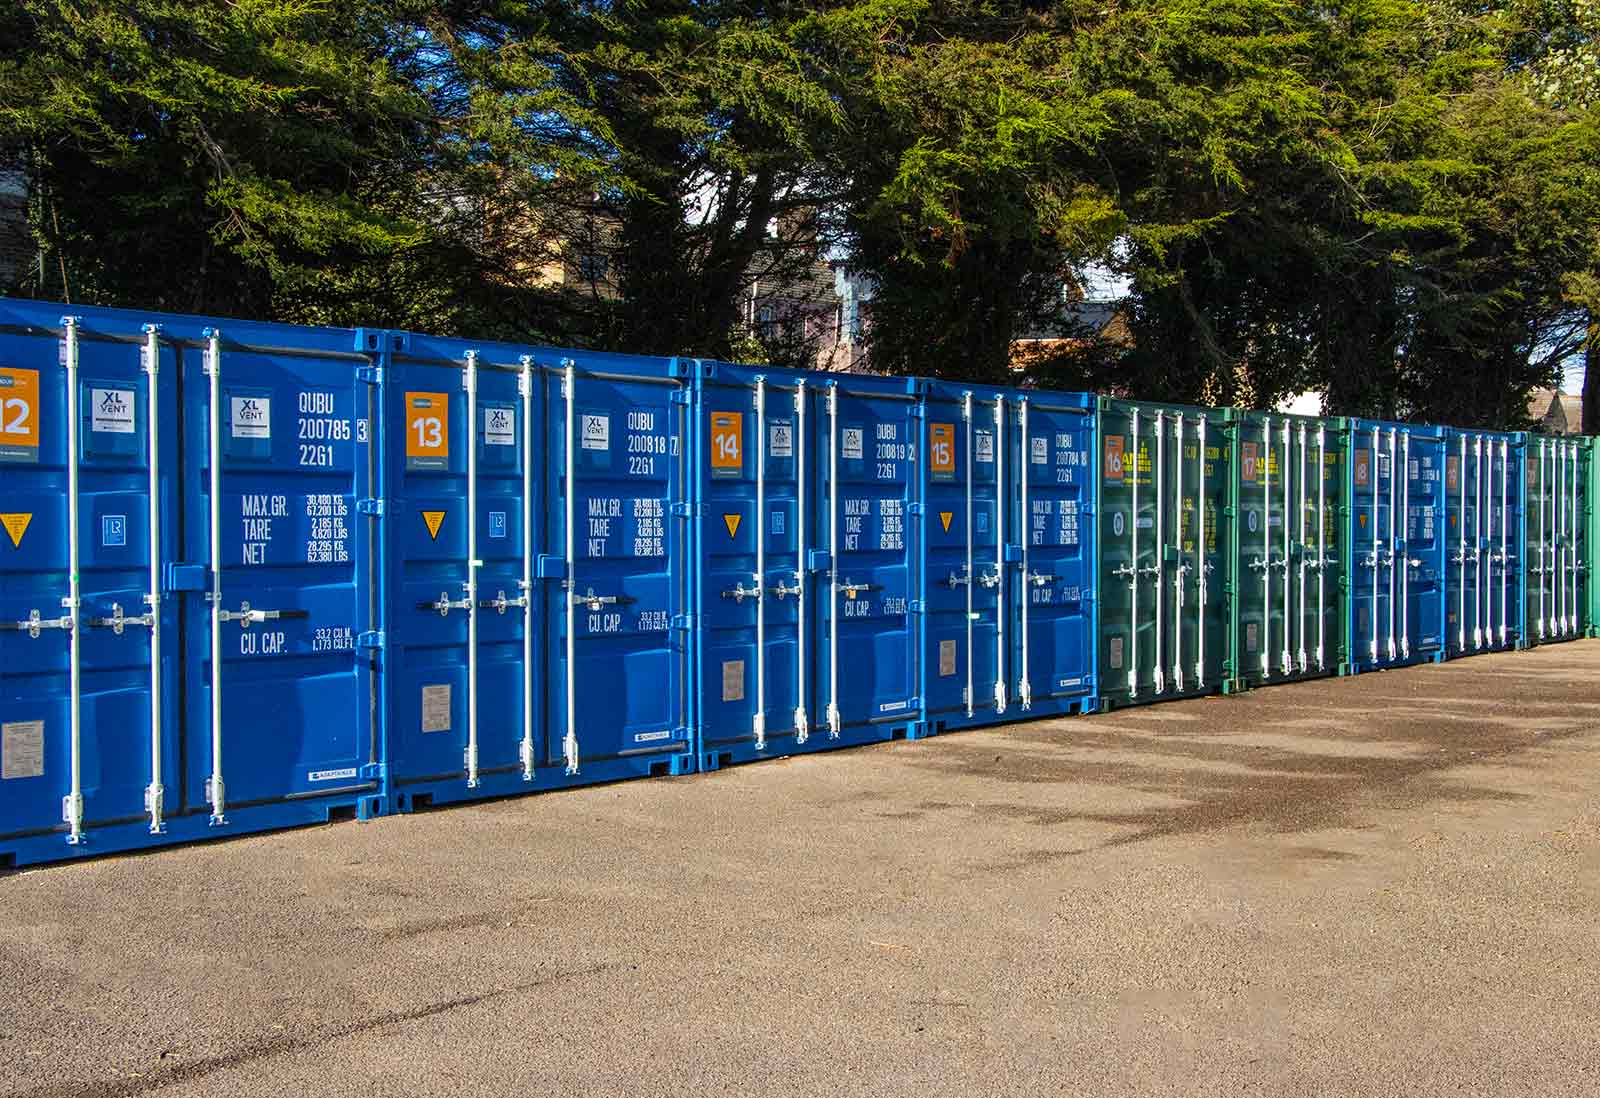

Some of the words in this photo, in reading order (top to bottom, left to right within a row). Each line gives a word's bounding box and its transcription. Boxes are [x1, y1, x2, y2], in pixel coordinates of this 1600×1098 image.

[103, 391, 122, 405] XL
[241, 399, 259, 411] XL
[299, 392, 334, 414] QUBU
[0, 397, 31, 434] 2
[100, 404, 127, 414] VENT
[239, 411, 263, 420] VENT
[491, 411, 507, 422] XL
[299, 418, 351, 440] 200785
[490, 421, 509, 429] VENT
[588, 417, 602, 427] XL
[627, 412, 654, 431] QUBU
[412, 417, 443, 448] 13
[627, 435, 666, 454] 200818
[715, 432, 739, 460] 14
[876, 443, 905, 460] 200819
[932, 442, 950, 465] 15
[300, 444, 334, 467] 22G1
[1107, 450, 1122, 473] 16
[629, 457, 655, 475] 22G1
[1245, 456, 1256, 475] 17
[242, 519, 272, 541] TARE
[588, 518, 611, 537] TARE
[588, 538, 607, 557] NET
[845, 533, 859, 550] NET
[242, 543, 268, 565] NET
